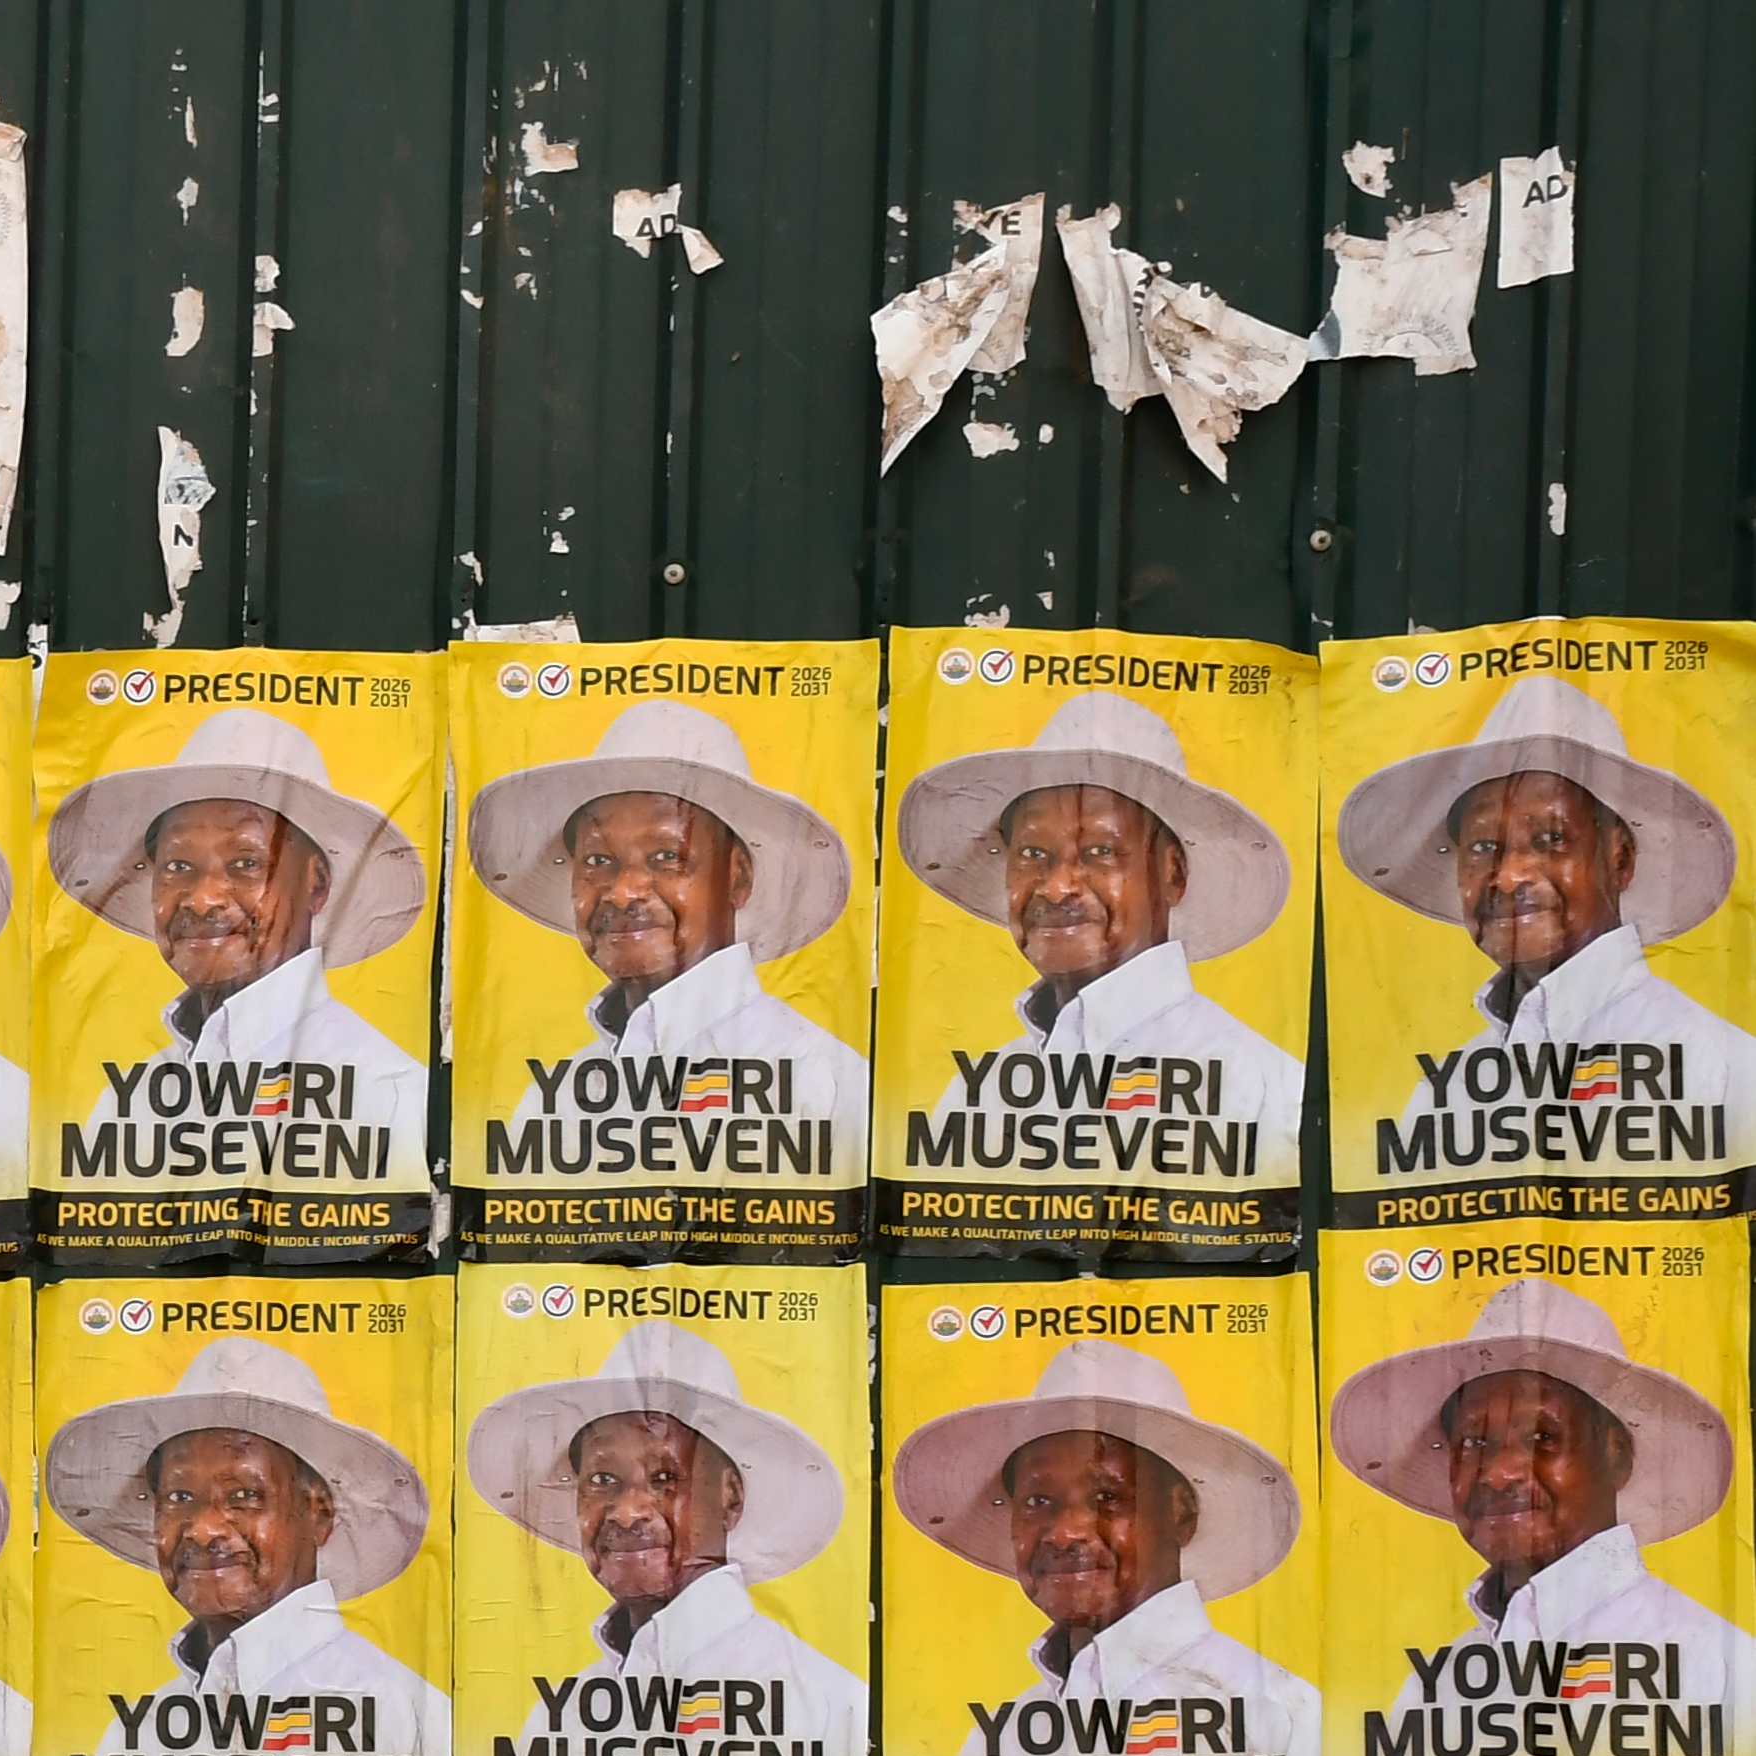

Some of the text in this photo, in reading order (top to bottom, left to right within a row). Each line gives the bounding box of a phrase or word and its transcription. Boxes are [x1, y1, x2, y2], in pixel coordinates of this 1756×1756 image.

[1461, 638, 1658, 681] PRESIDENT
[1664, 655, 1704, 670] 2031
[1665, 641, 1708, 655] 2026
[165, 673, 364, 705] PRESIDENT
[581, 664, 785, 696] PRESIDENT
[1024, 655, 1223, 692] PRESIDENT
[62, 1121, 389, 1179] MUSEVENI
[487, 1117, 831, 1174] MUSEVENI
[907, 1112, 1257, 1176] MUSEVENI
[1377, 1104, 1725, 1174] MUSEVENI
[486, 1194, 834, 1224] PROTECTING THE GAINS
[461, 1231, 857, 1245] AS WE MAKE A QUALITATIVE LEAP INTO HIGH MIDDLE INCOME STATUS
[1453, 1244, 1655, 1279] PRESIDENT
[163, 1301, 361, 1332] PRESIDENT
[585, 1287, 772, 1319] PRESIDENT
[1016, 1304, 1220, 1338] PRESIDENT
